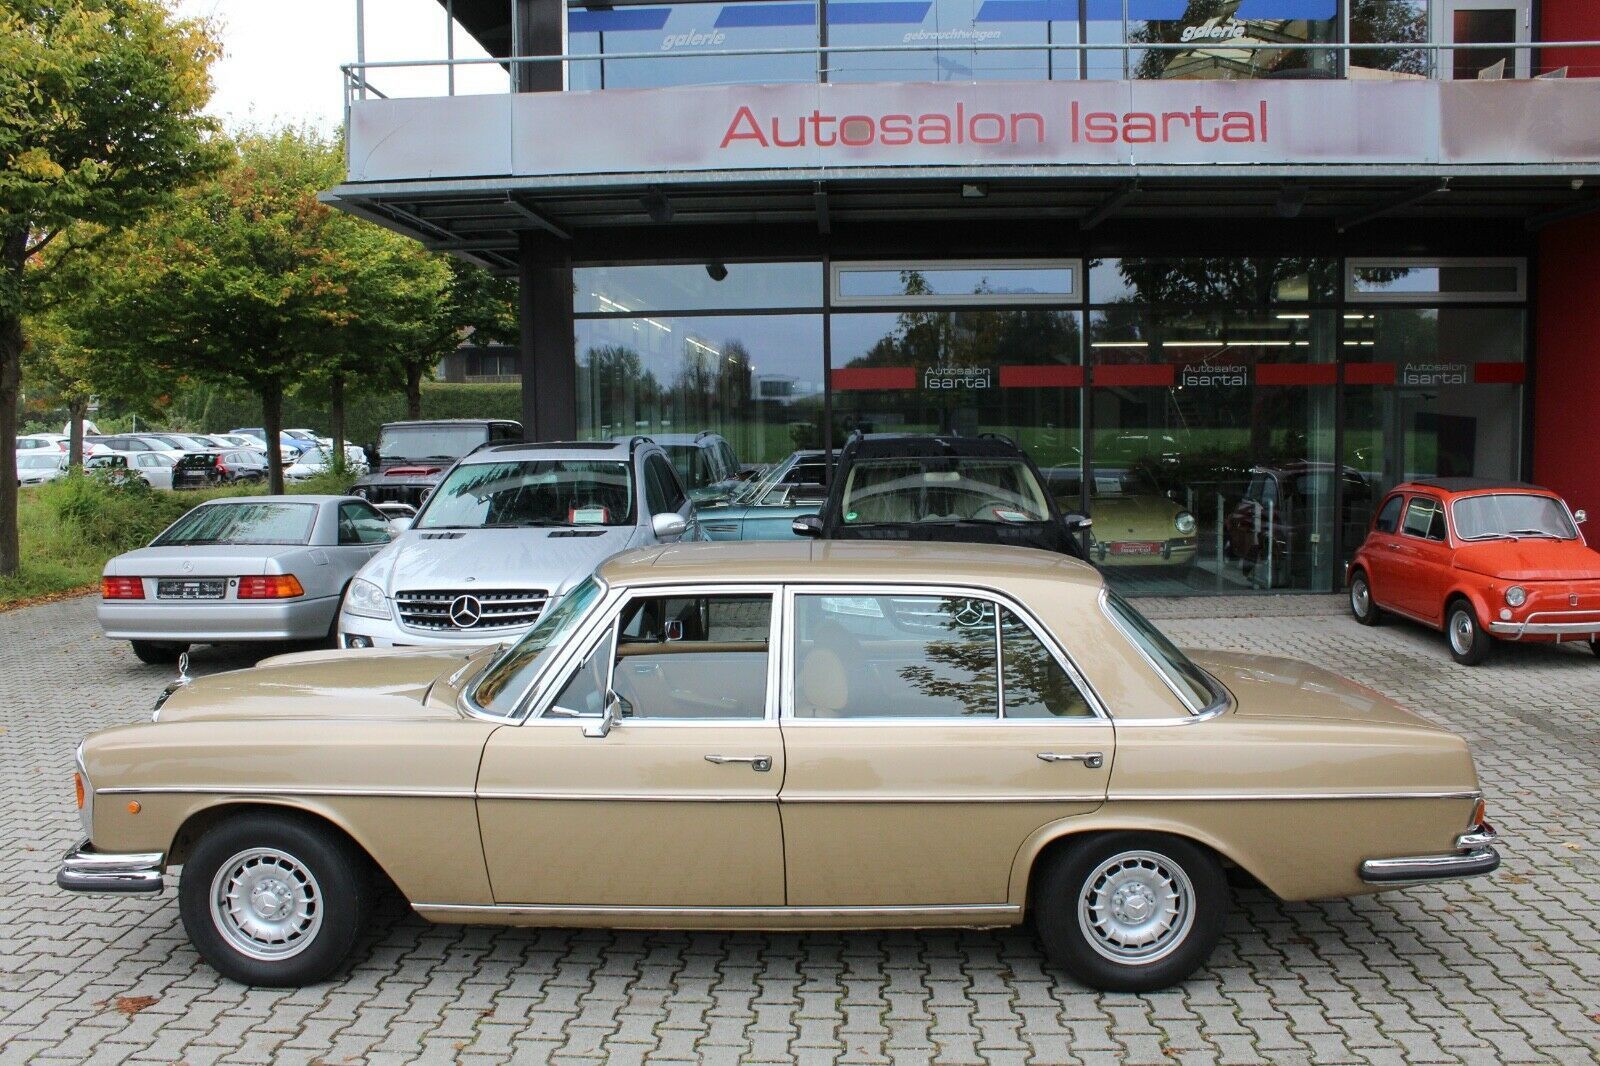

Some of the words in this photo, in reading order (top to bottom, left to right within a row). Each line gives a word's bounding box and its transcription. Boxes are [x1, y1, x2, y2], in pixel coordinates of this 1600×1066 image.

[661, 28, 726, 50] galerie
[902, 29, 1001, 43] gebrauchtwagen
[1180, 22, 1245, 42] galerie
[719, 102, 1046, 149] Autosalon
[1071, 100, 1268, 144] Isartal
[924, 366, 991, 376] Autosalon
[1183, 364, 1248, 373] Autosalon
[1404, 362, 1467, 371] Autosalon
[924, 374, 991, 389] Isartal
[1182, 372, 1248, 386] Isartal
[1403, 371, 1467, 385] Isartal
